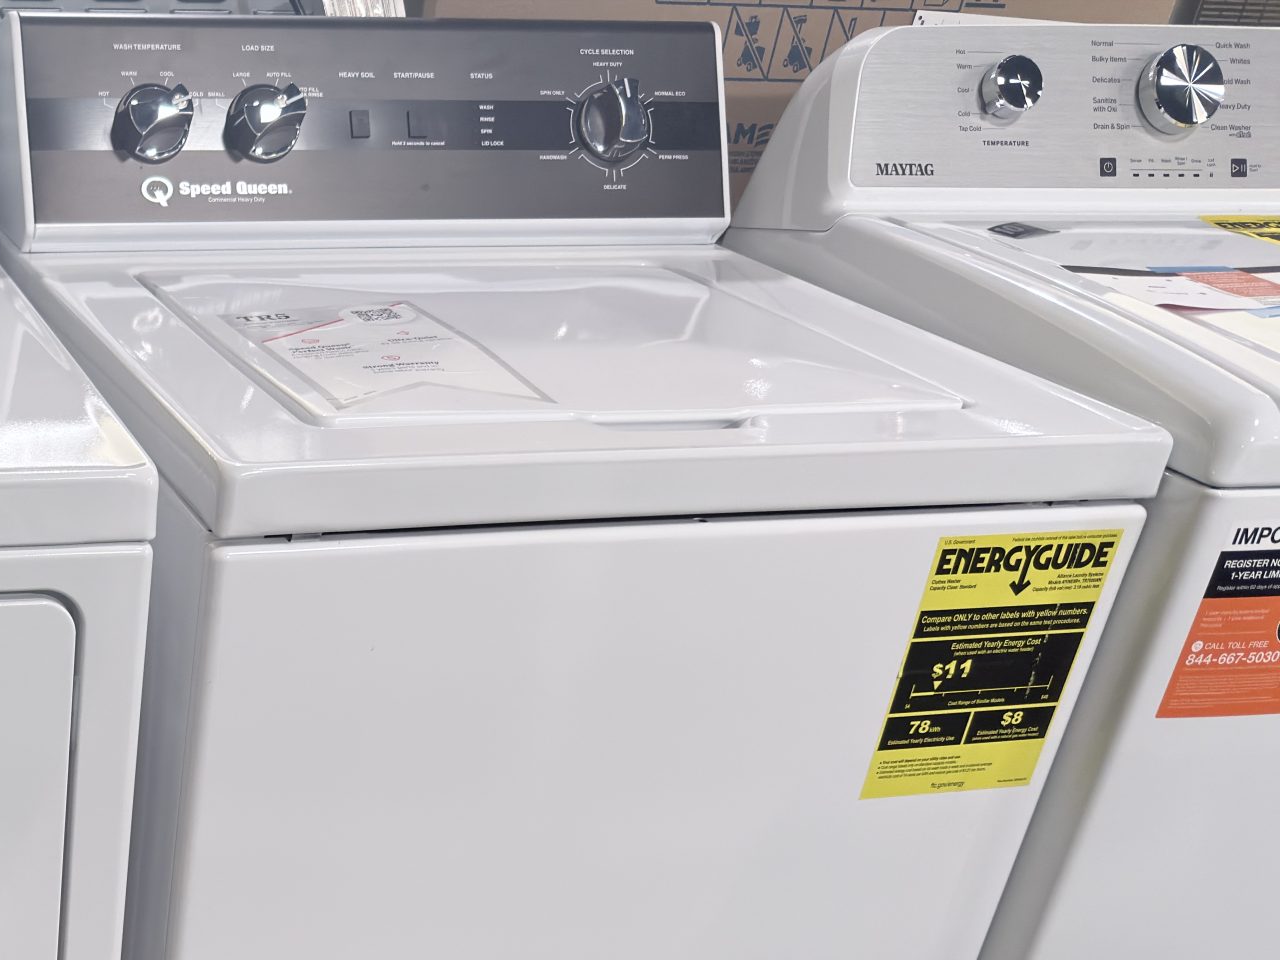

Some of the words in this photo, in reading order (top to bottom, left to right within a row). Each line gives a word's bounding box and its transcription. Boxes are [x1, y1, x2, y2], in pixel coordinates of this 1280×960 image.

[113, 43, 132, 51] WASH
[1236, 103, 1251, 111] Duty
[1116, 123, 1131, 131] Spin
[876, 163, 934, 177] MAYTAG
[179, 181, 232, 198] Speed
[236, 181, 288, 195] Queen
[235, 313, 290, 322] TR5
[935, 541, 1115, 575] ENERGYGUIDE
[1224, 559, 1269, 569] REGISTER
[1231, 571, 1262, 580] 1-YEAR
[921, 616, 952, 624] Compare
[953, 613, 973, 622] ONLY
[981, 612, 999, 620] other
[1000, 611, 1020, 619] labels
[1021, 610, 1035, 618] with
[1036, 609, 1058, 619] yellow
[951, 642, 984, 650] Estimated
[983, 640, 1003, 648] Yearly
[1003, 639, 1026, 647] Energy
[1204, 642, 1225, 650] CALL
[1227, 641, 1246, 649] TOLL
[1248, 640, 1269, 648] FREE
[1185, 650, 1280, 665] 844-667-5030
[931, 658, 973, 679] $11
[1000, 711, 1024, 727] $8
[909, 720, 931, 734] 78
